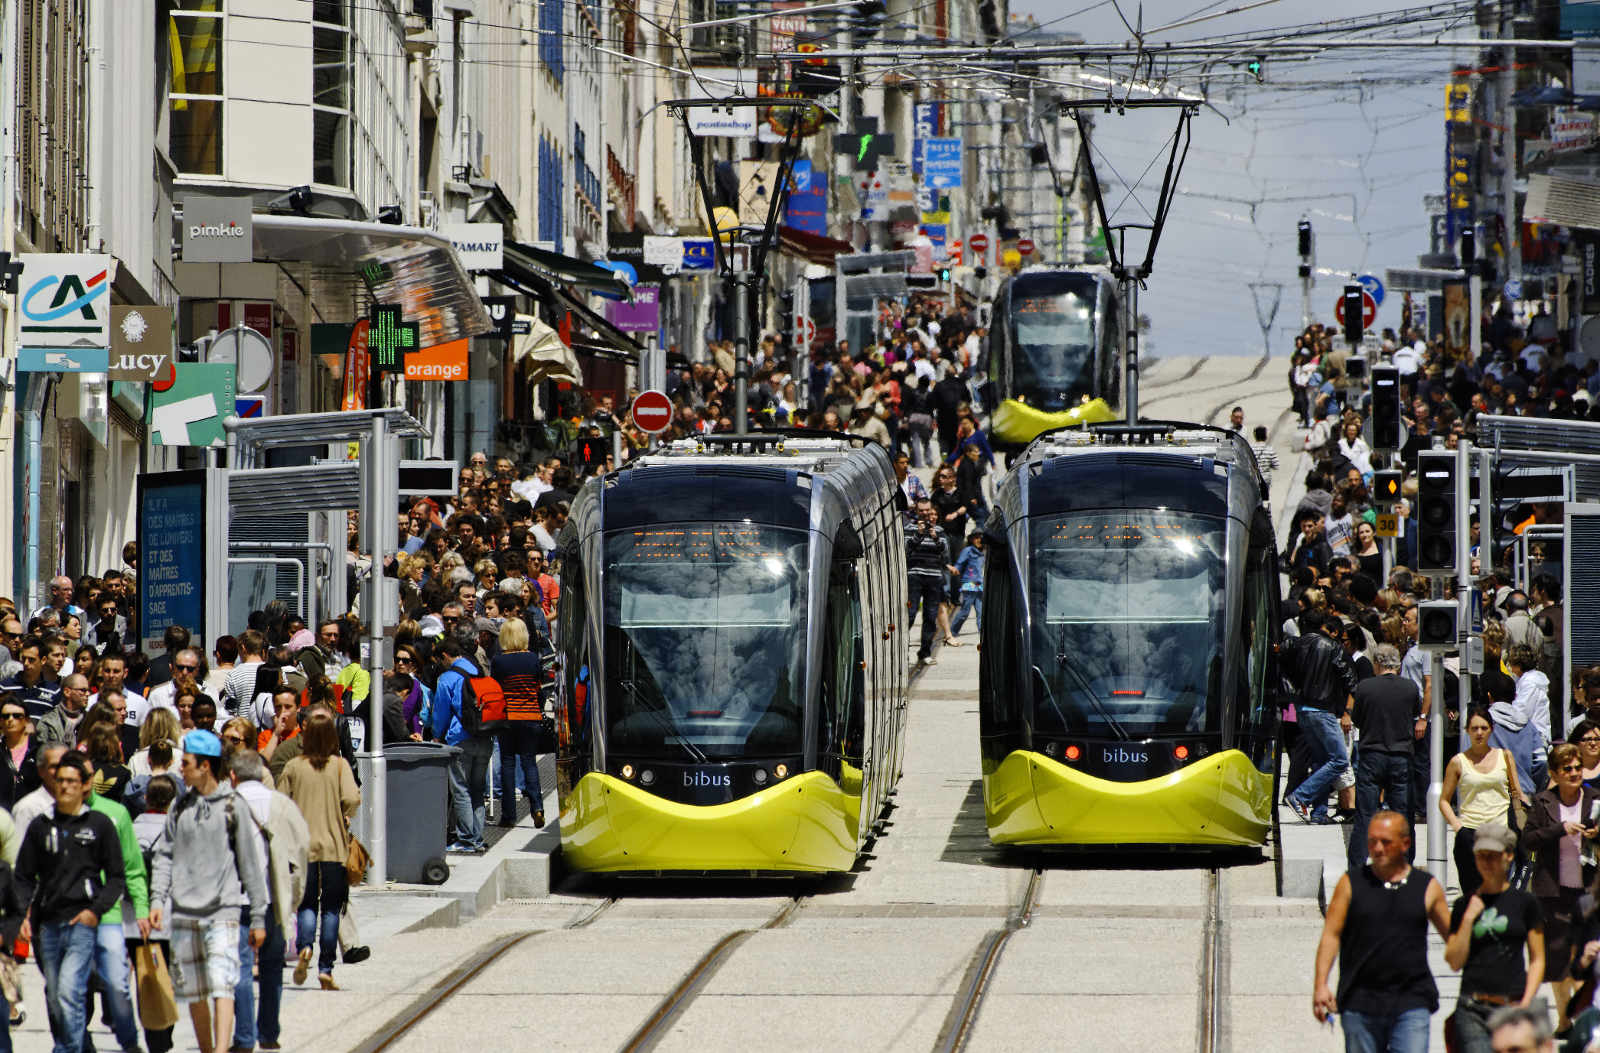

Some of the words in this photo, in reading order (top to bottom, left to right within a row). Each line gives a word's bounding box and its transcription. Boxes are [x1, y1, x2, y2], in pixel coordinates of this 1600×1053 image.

[190, 220, 244, 239] pimkie
[452, 241, 499, 251] AMART
[407, 364, 462, 379] orange
[1379, 519, 1395, 531] 30
[149, 551, 158, 564] ET
[160, 549, 174, 563] DES
[149, 564, 179, 581] MAÎTRES
[149, 601, 167, 615] SAGE
[1103, 748, 1149, 763] bibus
[683, 771, 731, 786] bibus
